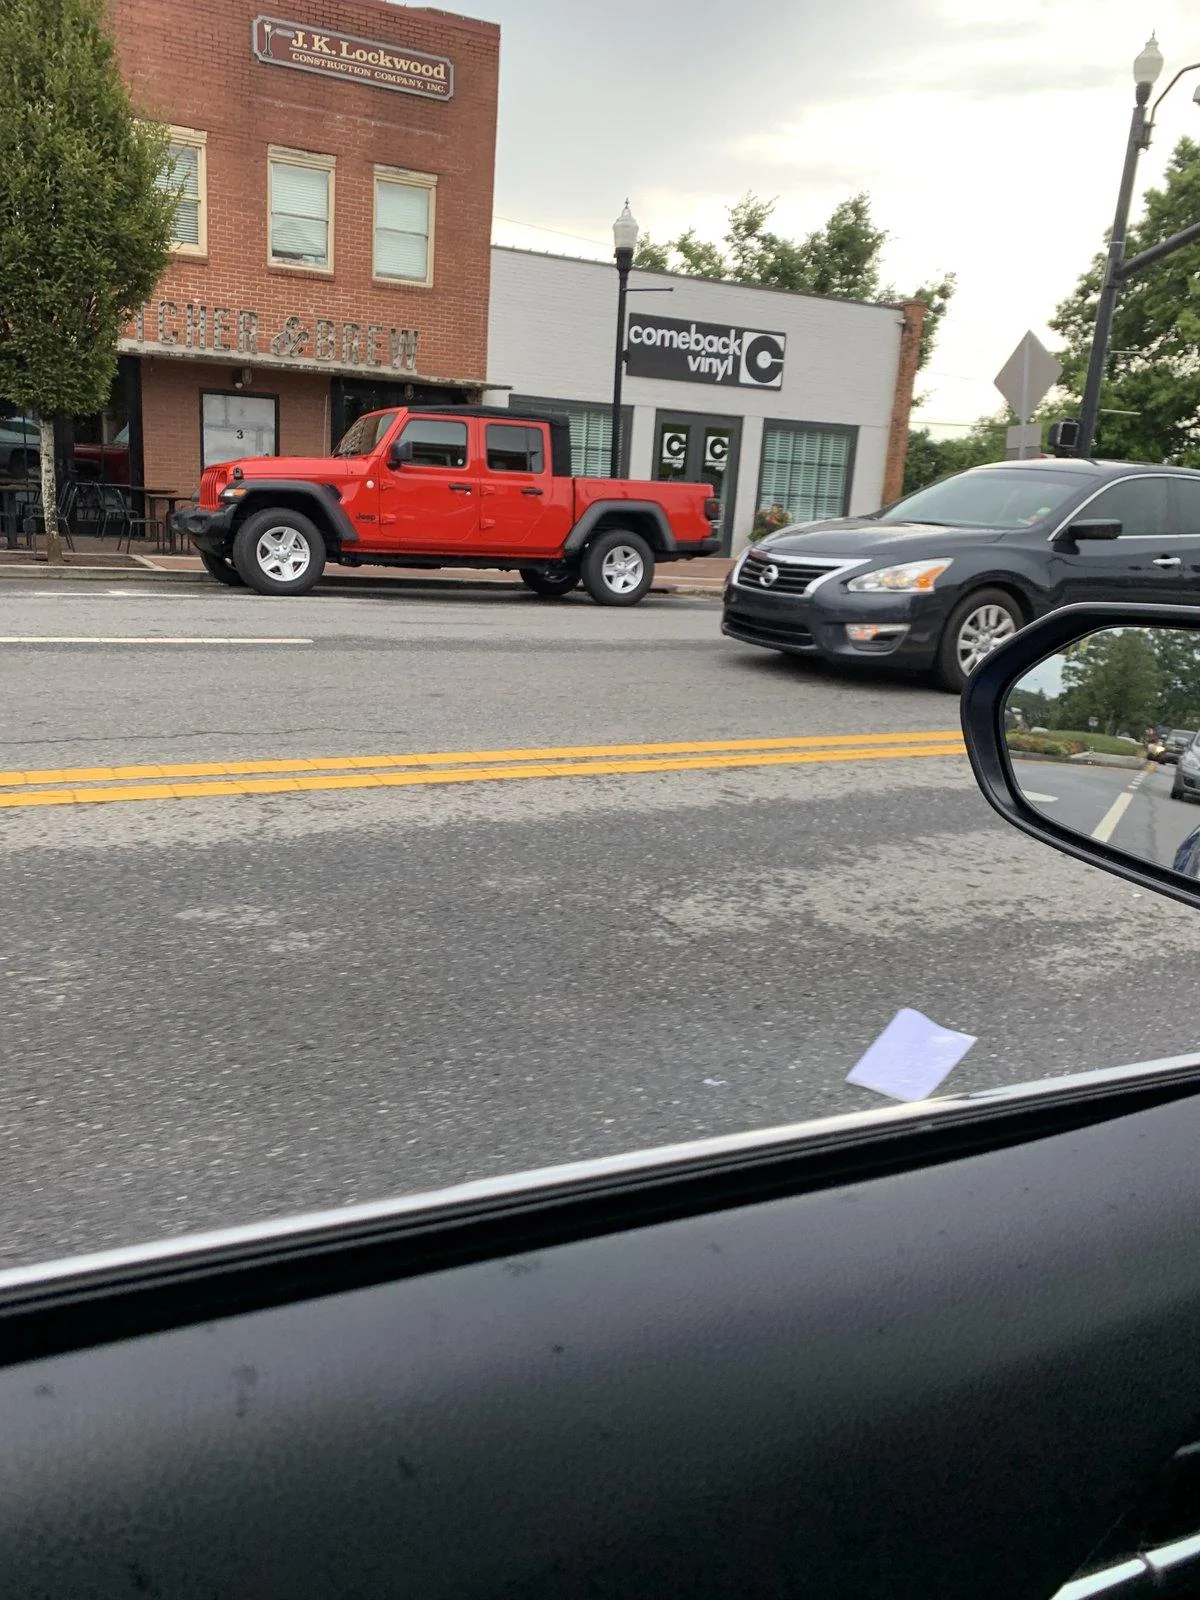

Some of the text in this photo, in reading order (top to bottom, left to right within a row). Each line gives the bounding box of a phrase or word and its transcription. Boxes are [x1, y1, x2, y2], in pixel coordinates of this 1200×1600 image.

[292, 52, 446, 94] CONSTRUCTION COMPANY, INC.
[340, 40, 446, 80] Lockwood
[270, 316, 310, 358] &
[315, 318, 420, 370] BREW
[629, 324, 742, 356] comeback
[687, 350, 734, 381] vinyl
[236, 429, 244, 440] 3
